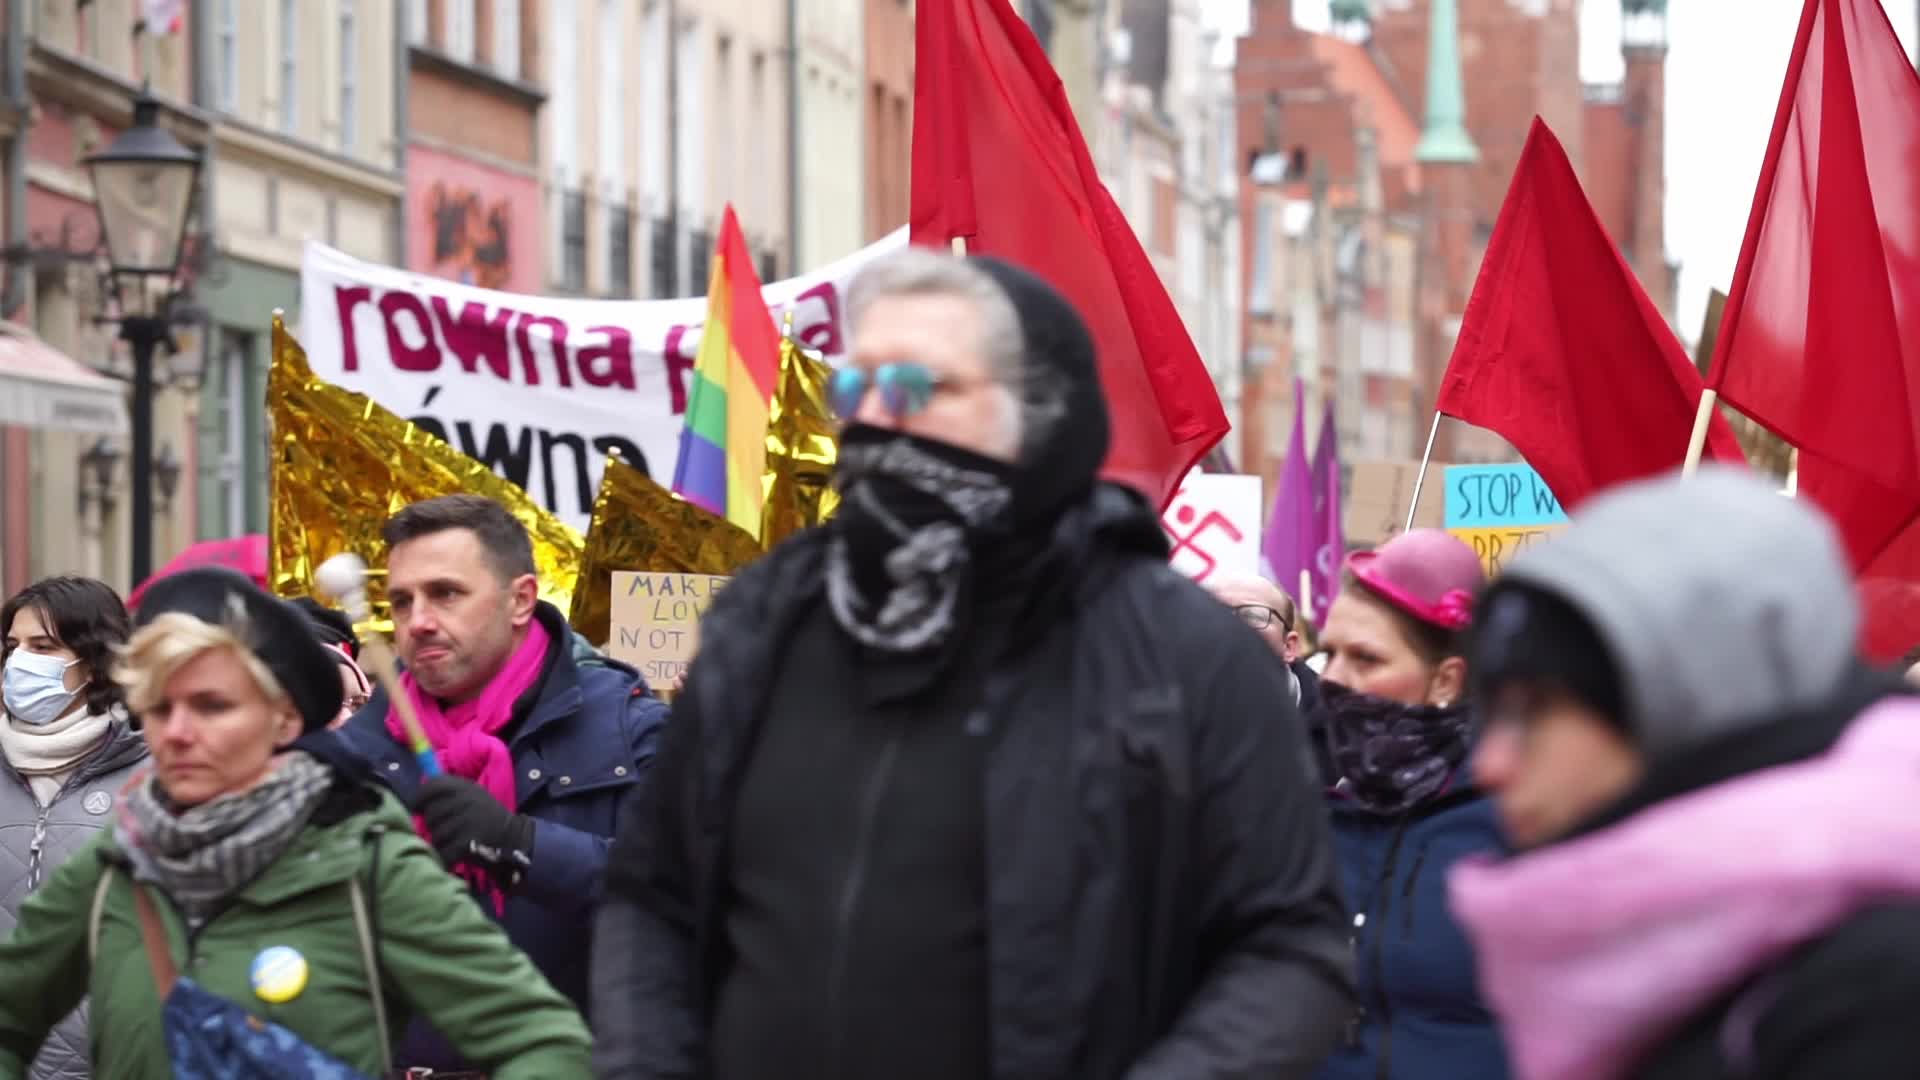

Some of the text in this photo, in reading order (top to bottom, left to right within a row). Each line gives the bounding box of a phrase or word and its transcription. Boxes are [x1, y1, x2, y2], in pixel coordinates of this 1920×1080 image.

[1457, 471, 1556, 519] STOP W
[628, 575, 729, 598] MAKE
[619, 627, 688, 652] NOT
